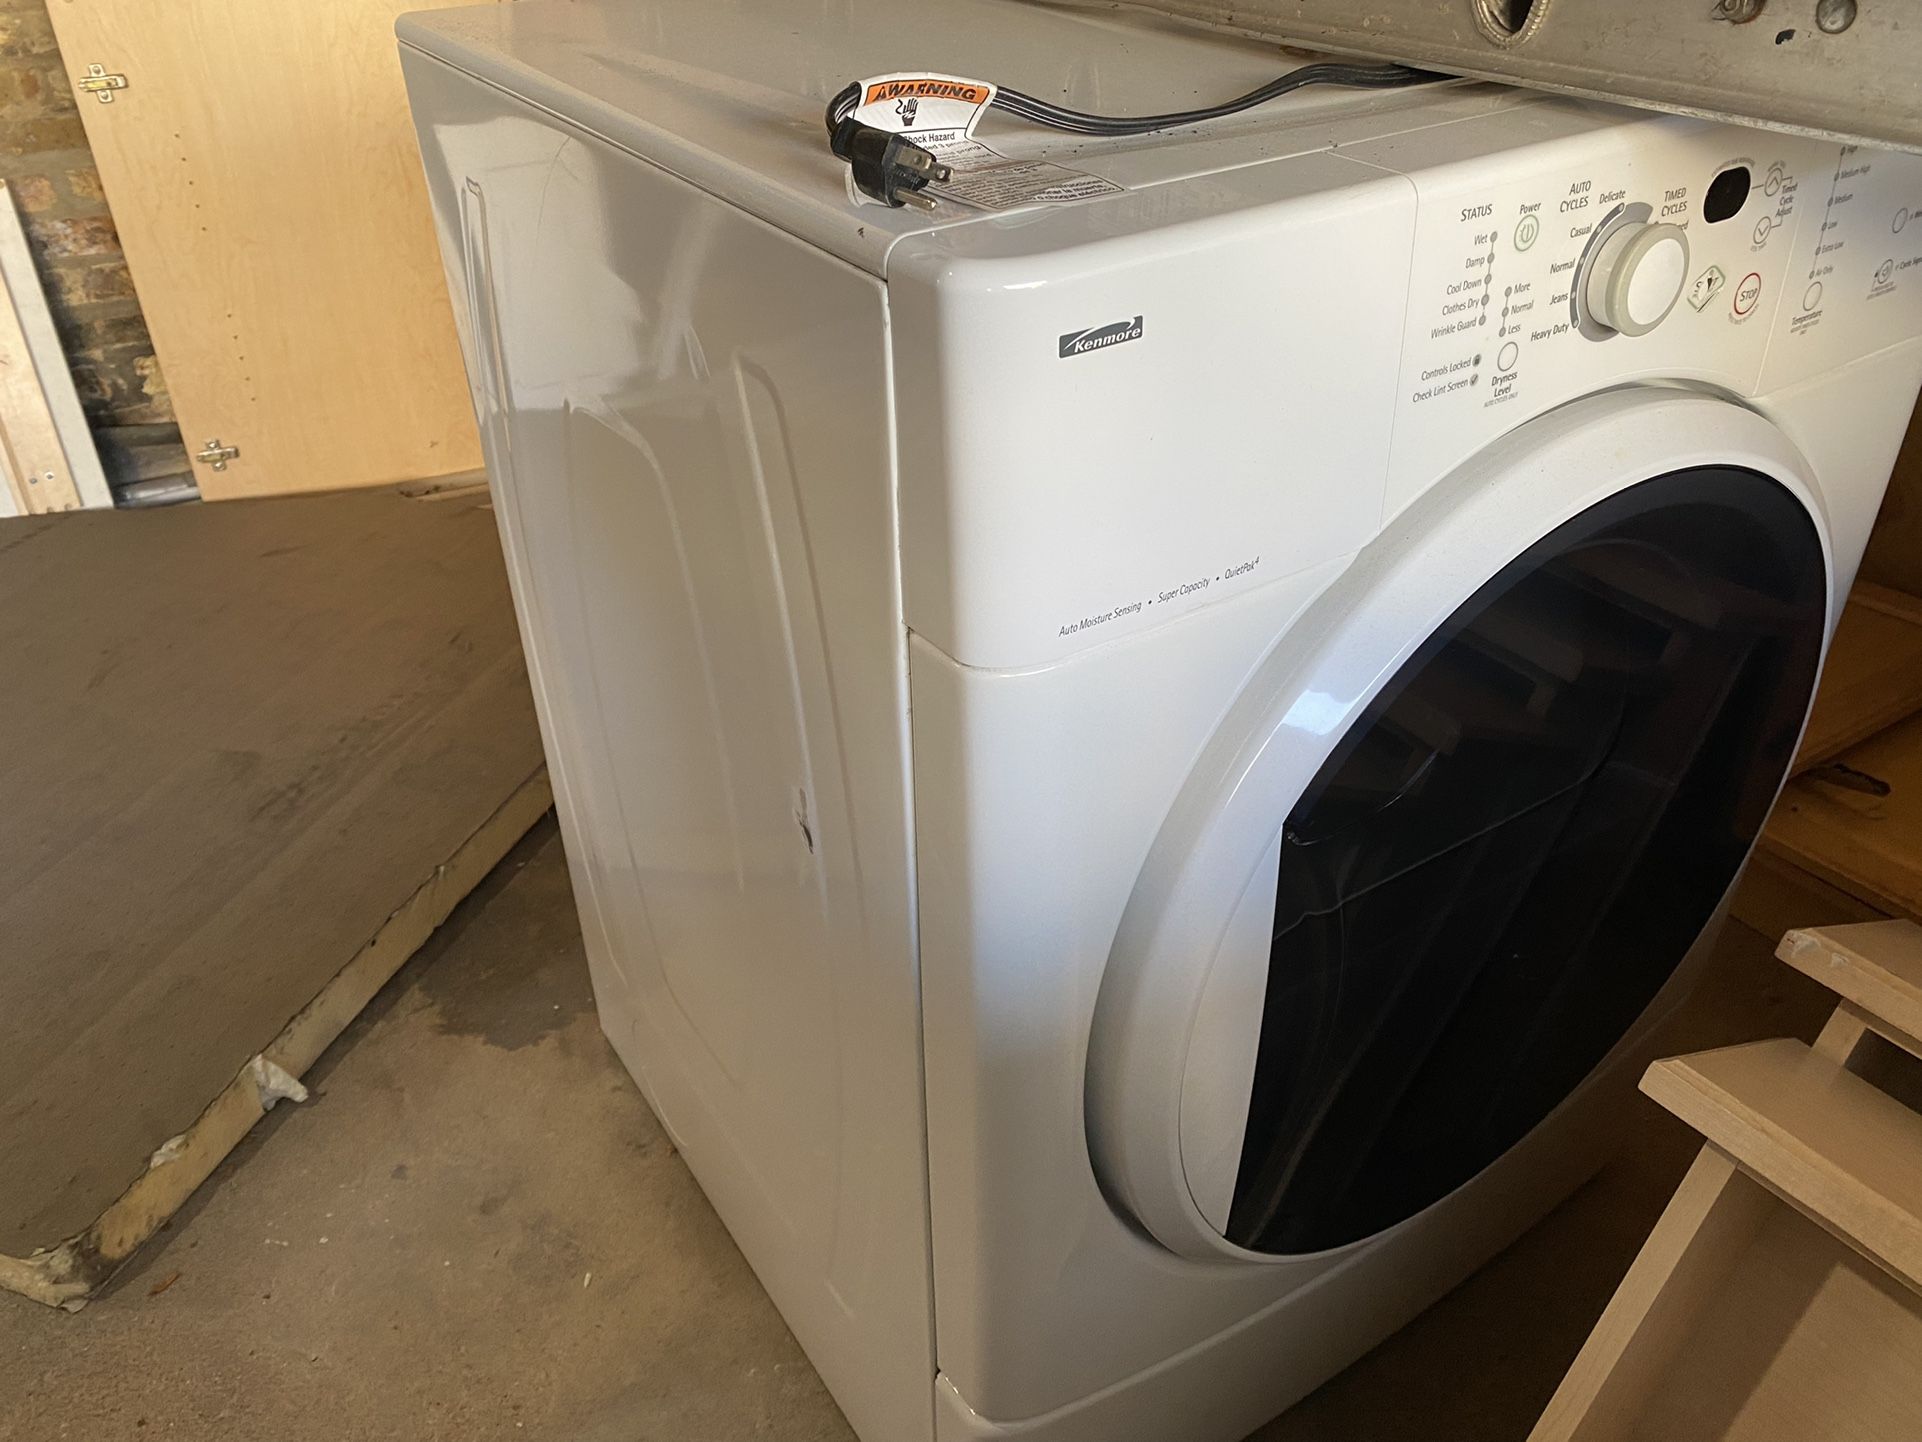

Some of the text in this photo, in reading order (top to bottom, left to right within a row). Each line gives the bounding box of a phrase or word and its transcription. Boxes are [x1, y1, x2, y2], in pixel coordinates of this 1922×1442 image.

[887, 81, 977, 101] WARNING
[928, 132, 955, 142] Hazard
[1569, 181, 1592, 195] AUTO
[1664, 187, 1687, 202] TIMED
[1560, 196, 1589, 213] CYCLES
[1599, 189, 1626, 204] Delicate
[1461, 204, 1493, 222] STATUS
[1519, 202, 1541, 215] Power
[1661, 201, 1688, 217] CYCLES
[1570, 223, 1592, 239] Casual
[1474, 234, 1488, 246] Wet
[1465, 256, 1485, 270] Damp
[1550, 258, 1575, 275] Normal
[1446, 278, 1482, 295] Cool Down
[1514, 282, 1531, 295] More
[1549, 292, 1569, 306] Jeans
[1740, 288, 1758, 302] STOP
[1442, 296, 1479, 316] Clothes Dry
[1511, 300, 1534, 315] Normal
[1430, 318, 1477, 339] Wrinkle Guard
[1508, 324, 1521, 335] Less
[1530, 318, 1570, 342] Heavy Duty
[1074, 327, 1141, 353] Kenmore
[1421, 358, 1472, 382] Controls Locked
[1491, 371, 1518, 387] Dryness
[1412, 378, 1469, 403] Check Lint Screen
[1493, 383, 1512, 398] Level
[1058, 623, 1079, 638] Auto
[1079, 611, 1113, 630] Moisture
[1113, 601, 1142, 619] Sensing
[1157, 588, 1180, 605] Super
[1179, 577, 1211, 597] Capacity
